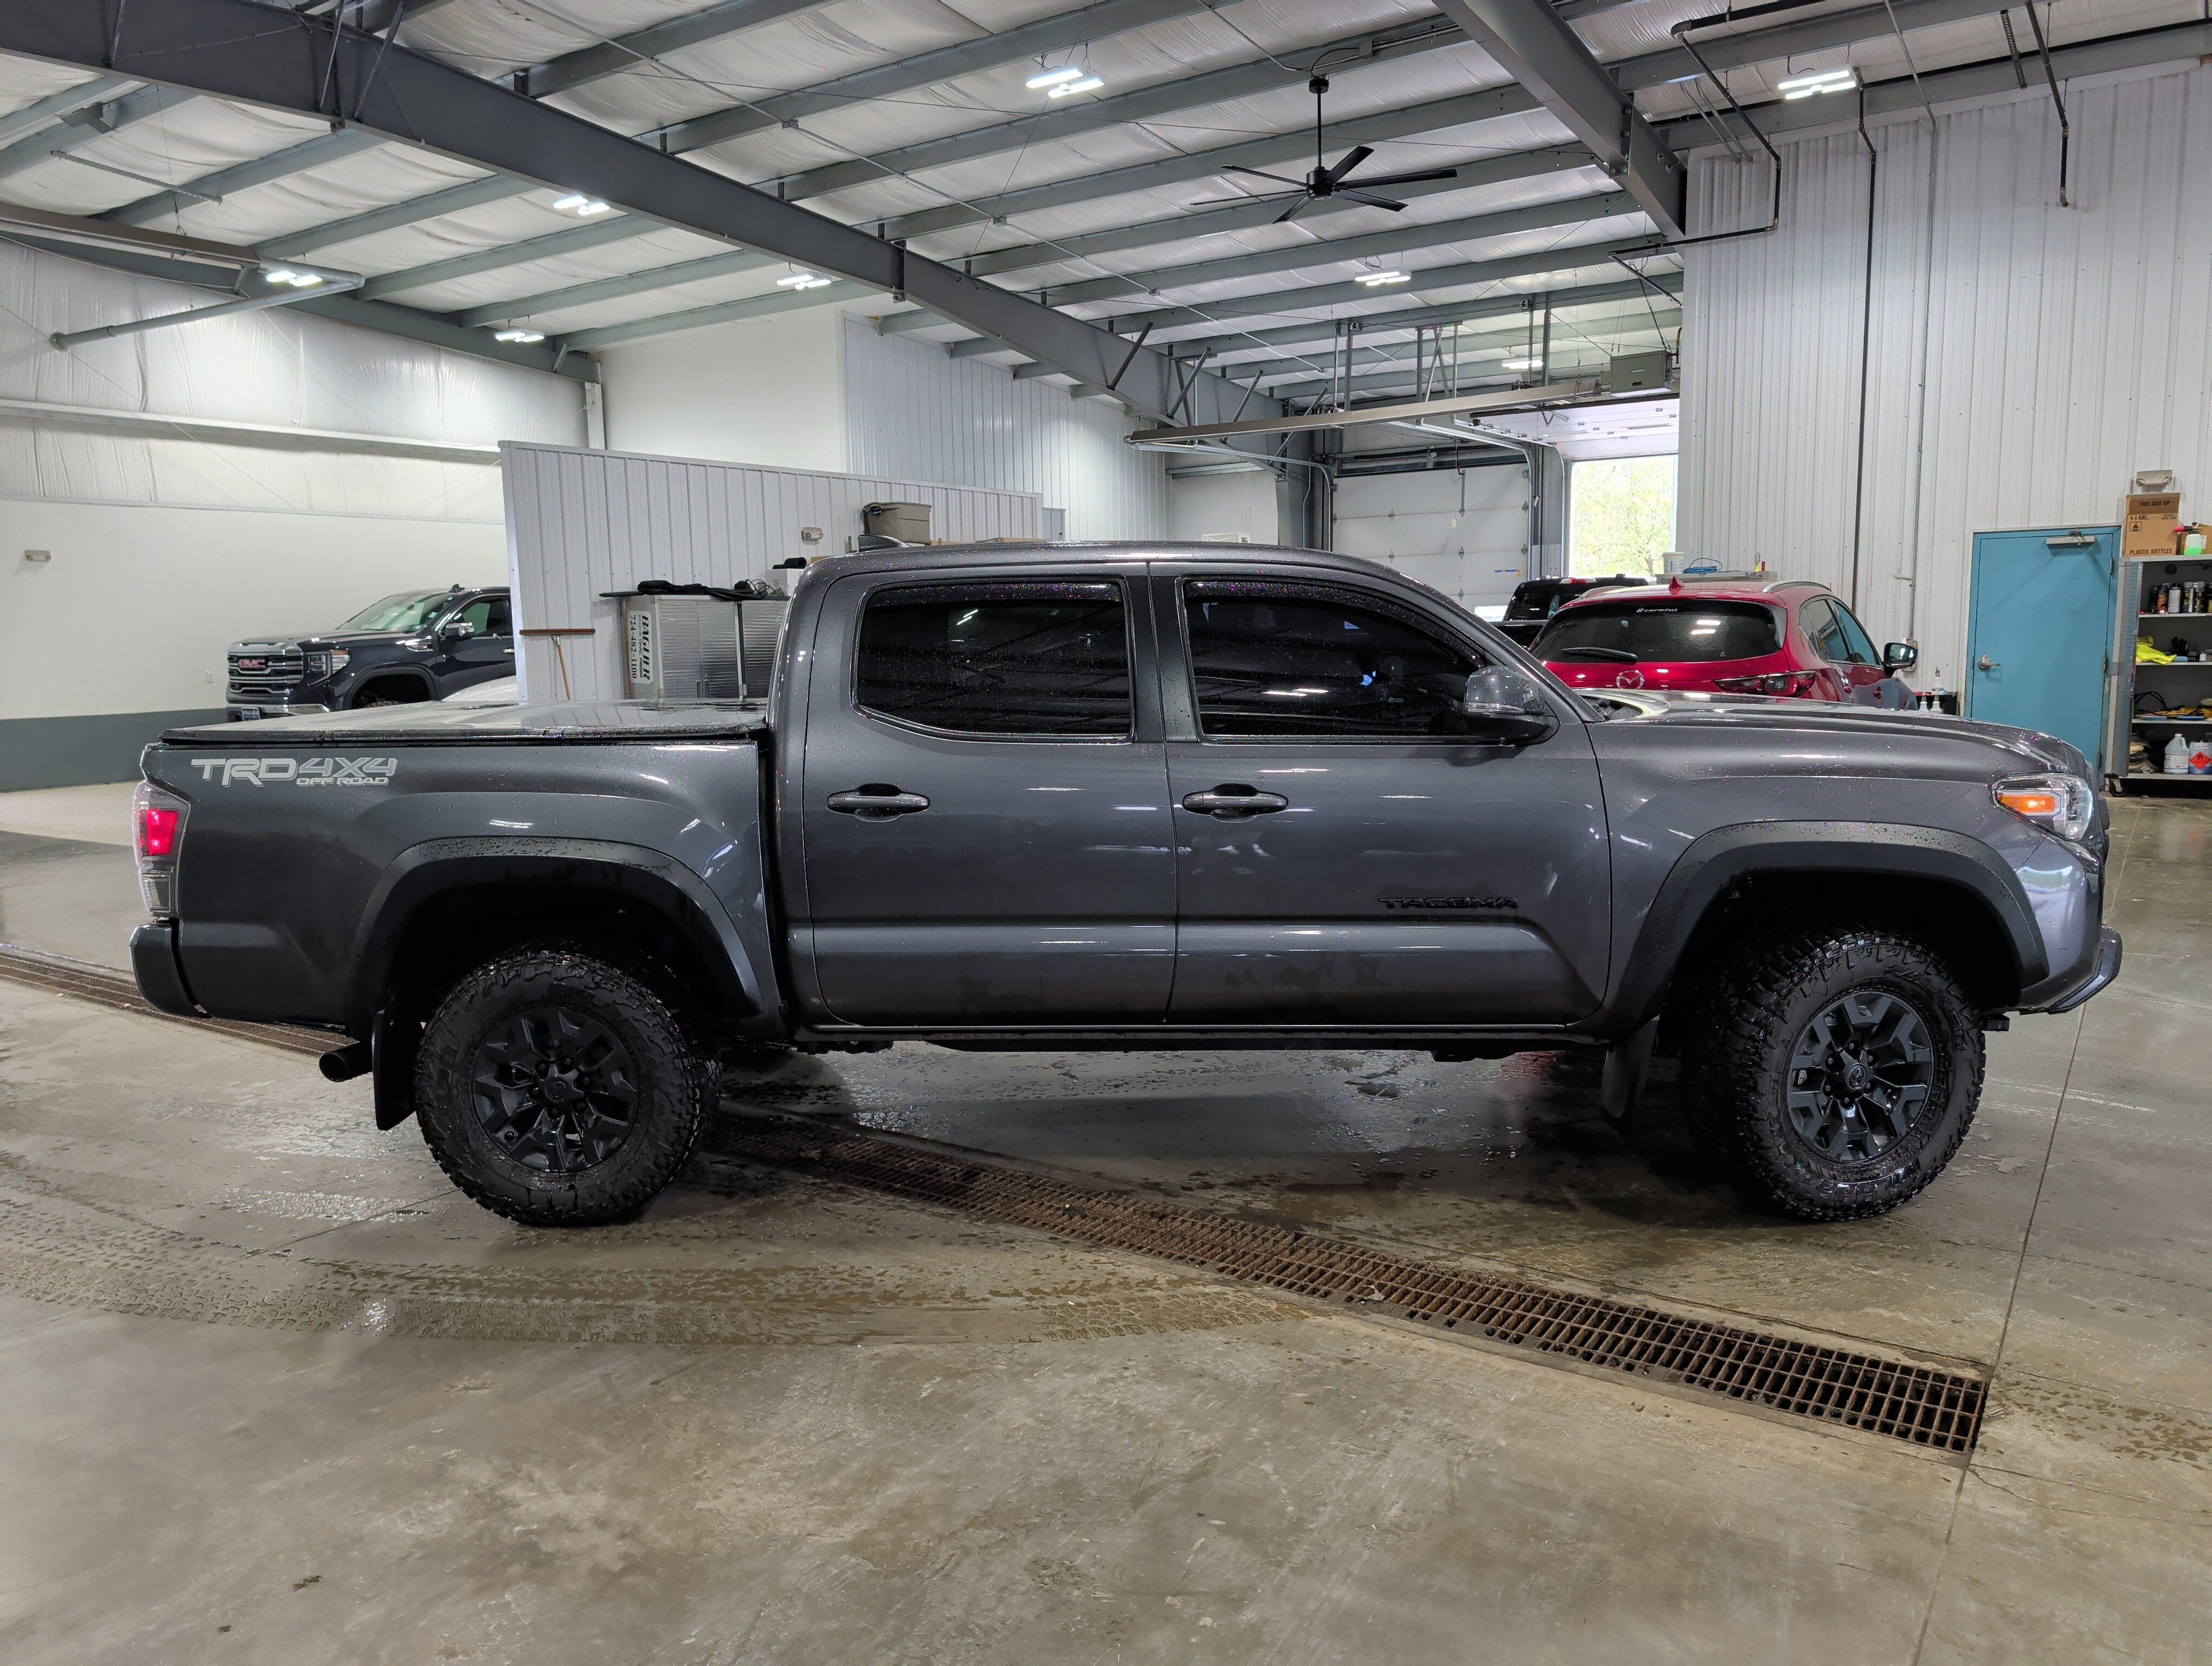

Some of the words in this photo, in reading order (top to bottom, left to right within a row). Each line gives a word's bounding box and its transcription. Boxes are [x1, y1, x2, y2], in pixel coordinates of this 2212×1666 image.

[642, 615, 650, 680] BAGLIER
[238, 658, 266, 669] GMC
[191, 758, 298, 787] TRD
[296, 777, 335, 787] OFF
[336, 777, 389, 786] ROAD
[1378, 897, 1519, 909] TACOMA
